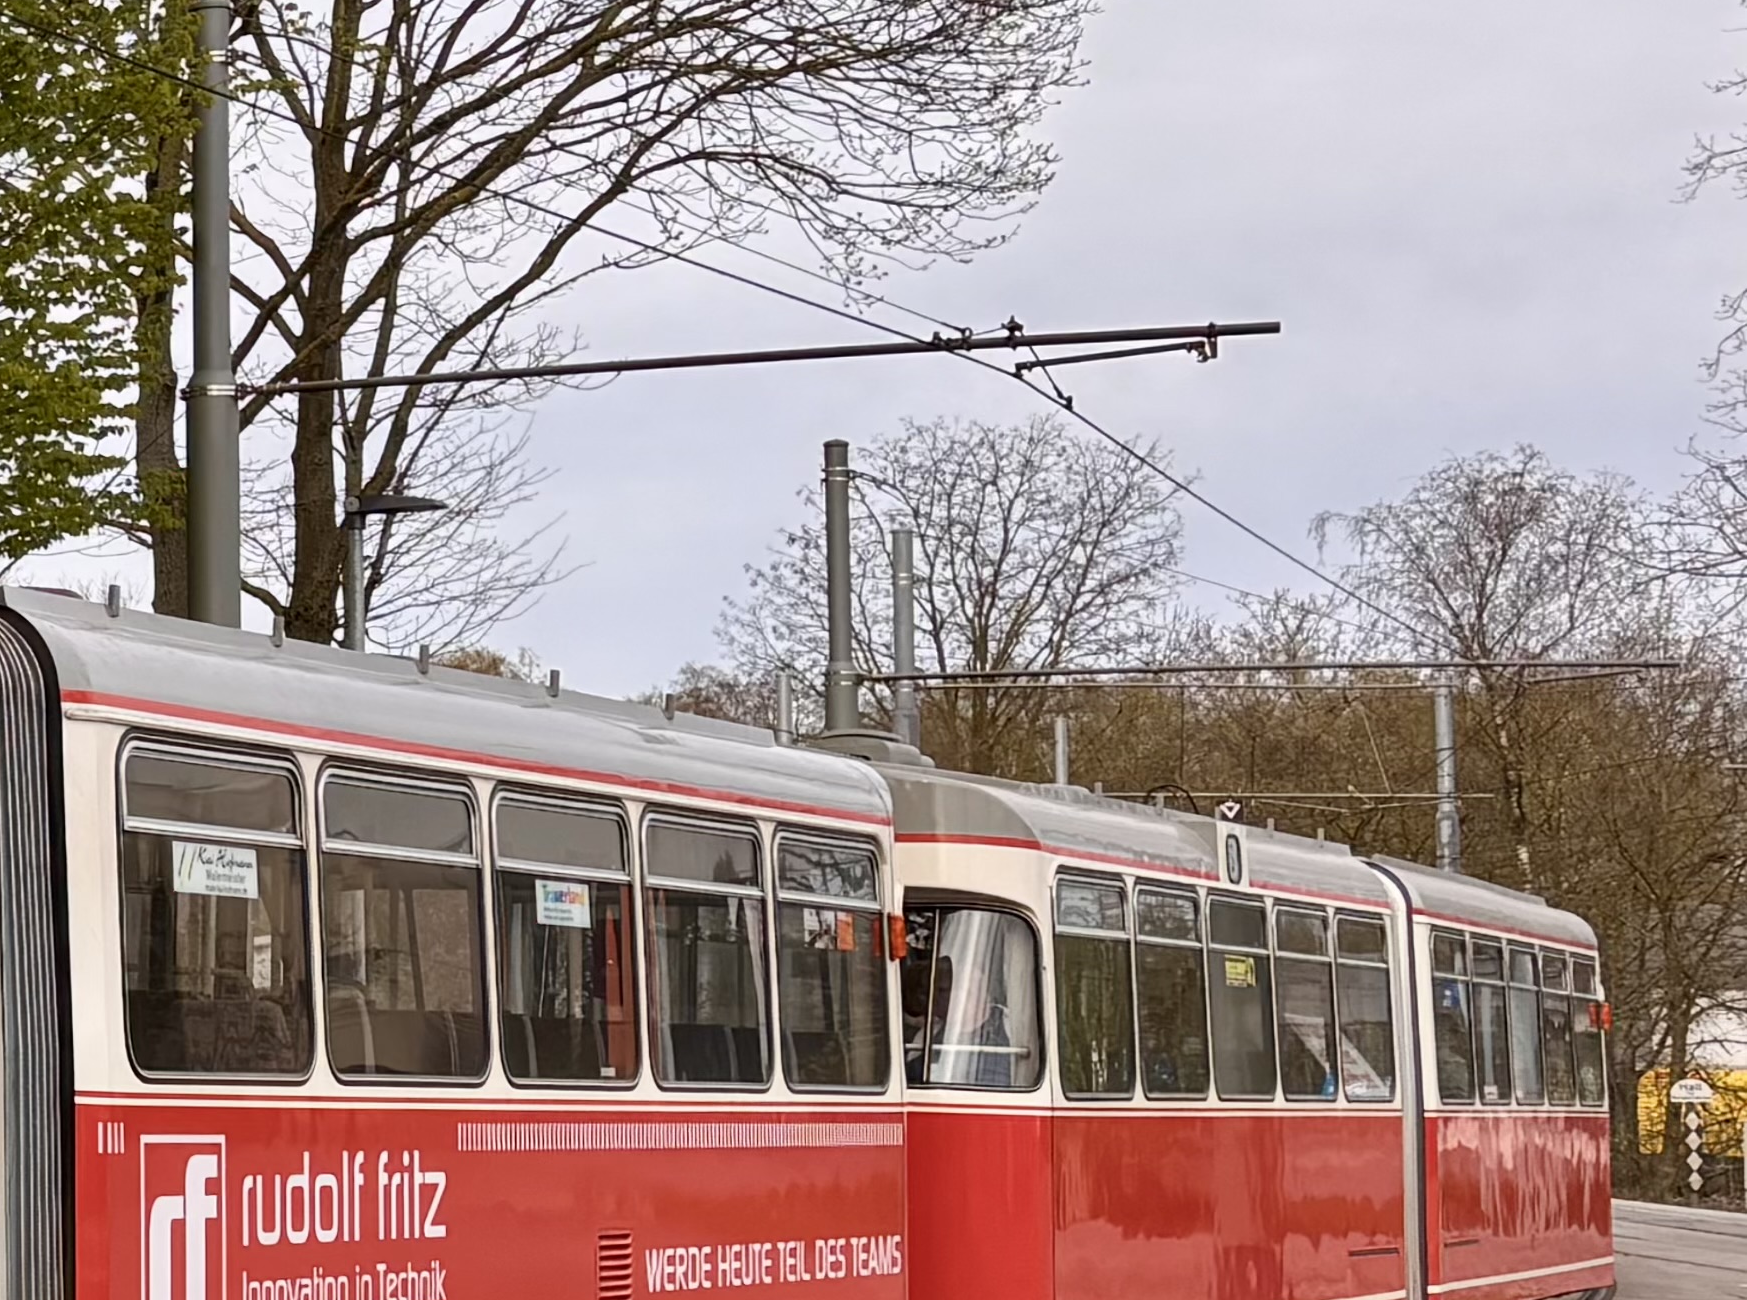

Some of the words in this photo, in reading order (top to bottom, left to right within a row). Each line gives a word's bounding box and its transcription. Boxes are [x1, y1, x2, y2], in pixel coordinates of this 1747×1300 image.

[242, 1150, 365, 1247] rudolf
[378, 1149, 447, 1241] fritz
[645, 1245, 712, 1293] WERDE
[717, 1241, 773, 1288] HEUTE
[776, 1239, 810, 1283] TEIL
[815, 1237, 847, 1280] DES
[849, 1234, 902, 1277] TEAMS
